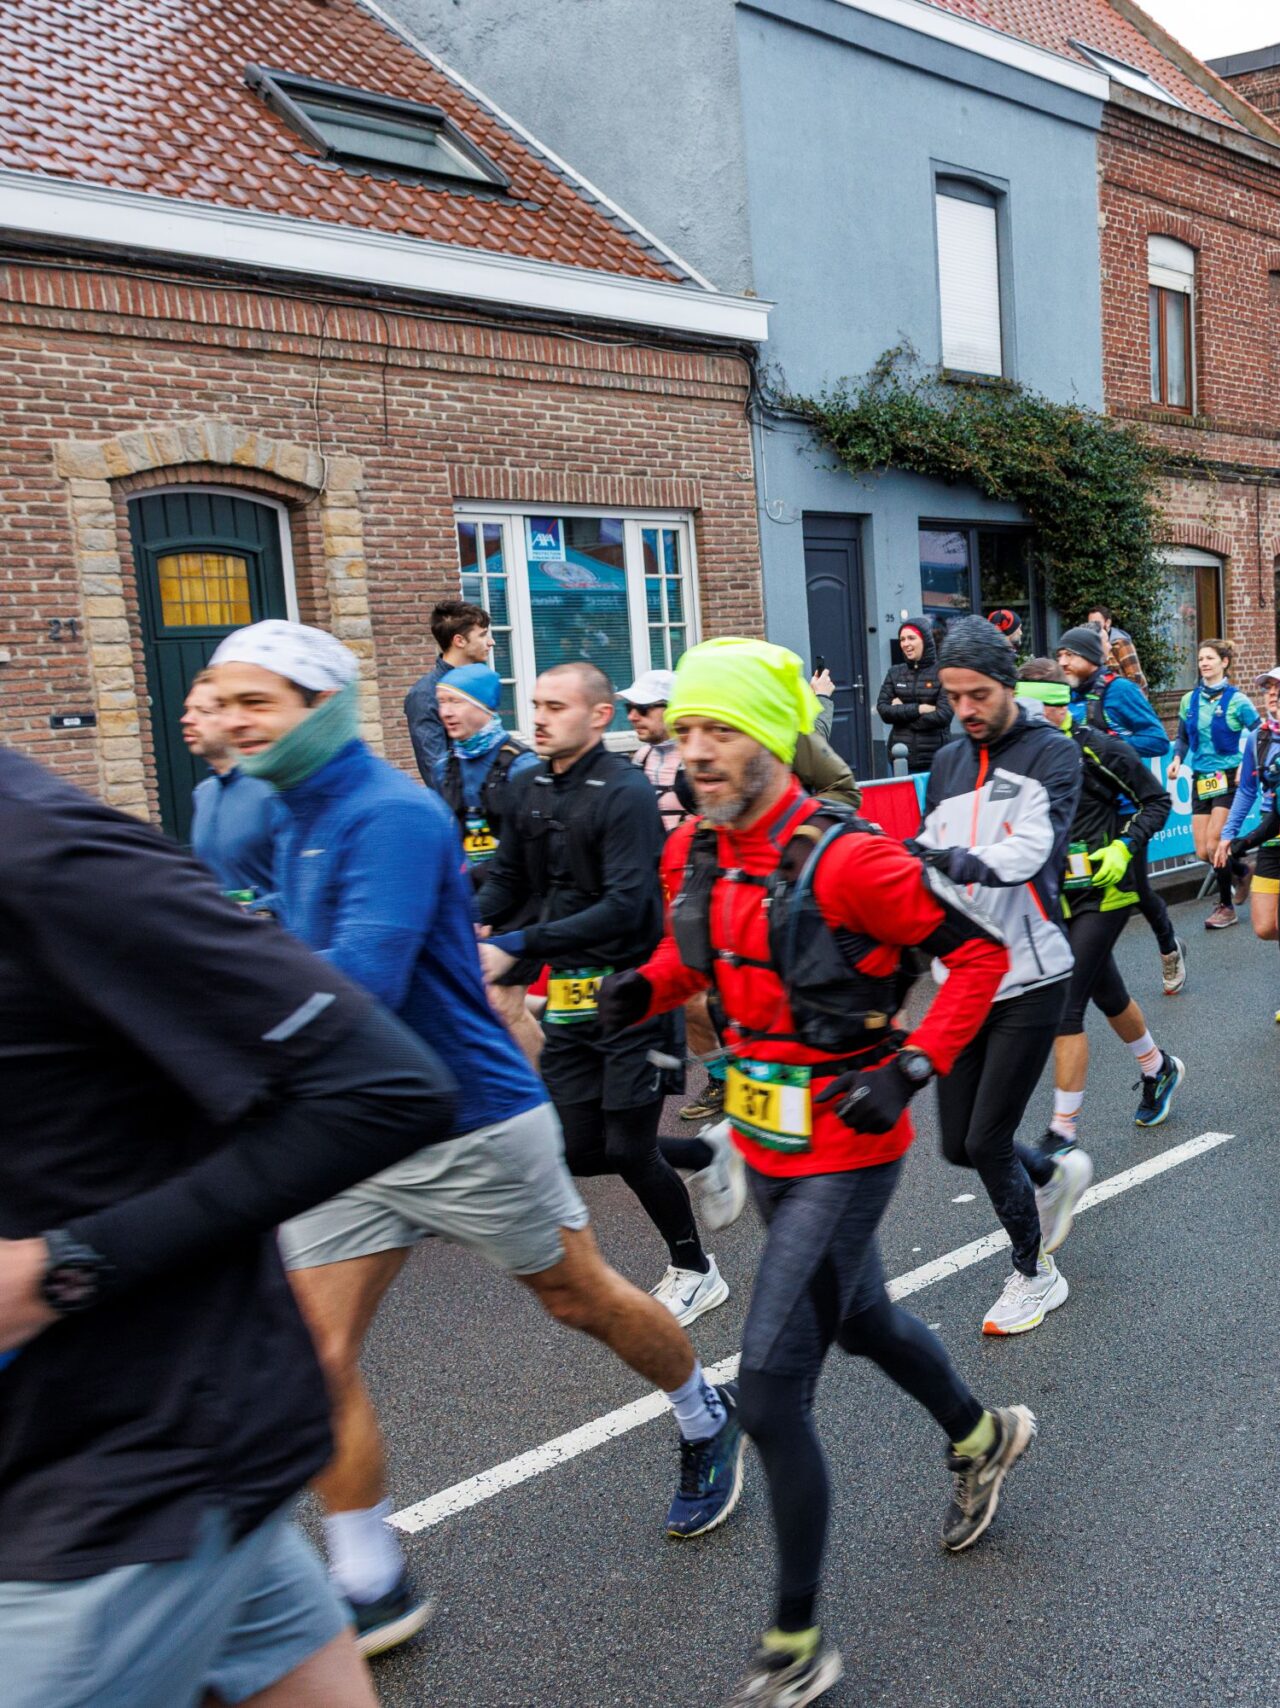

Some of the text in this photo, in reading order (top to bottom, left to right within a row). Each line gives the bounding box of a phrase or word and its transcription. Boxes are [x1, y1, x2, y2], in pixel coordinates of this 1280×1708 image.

[532, 533, 556, 547] AXA
[48, 618, 77, 640] 21
[1205, 779, 1217, 790] 90
